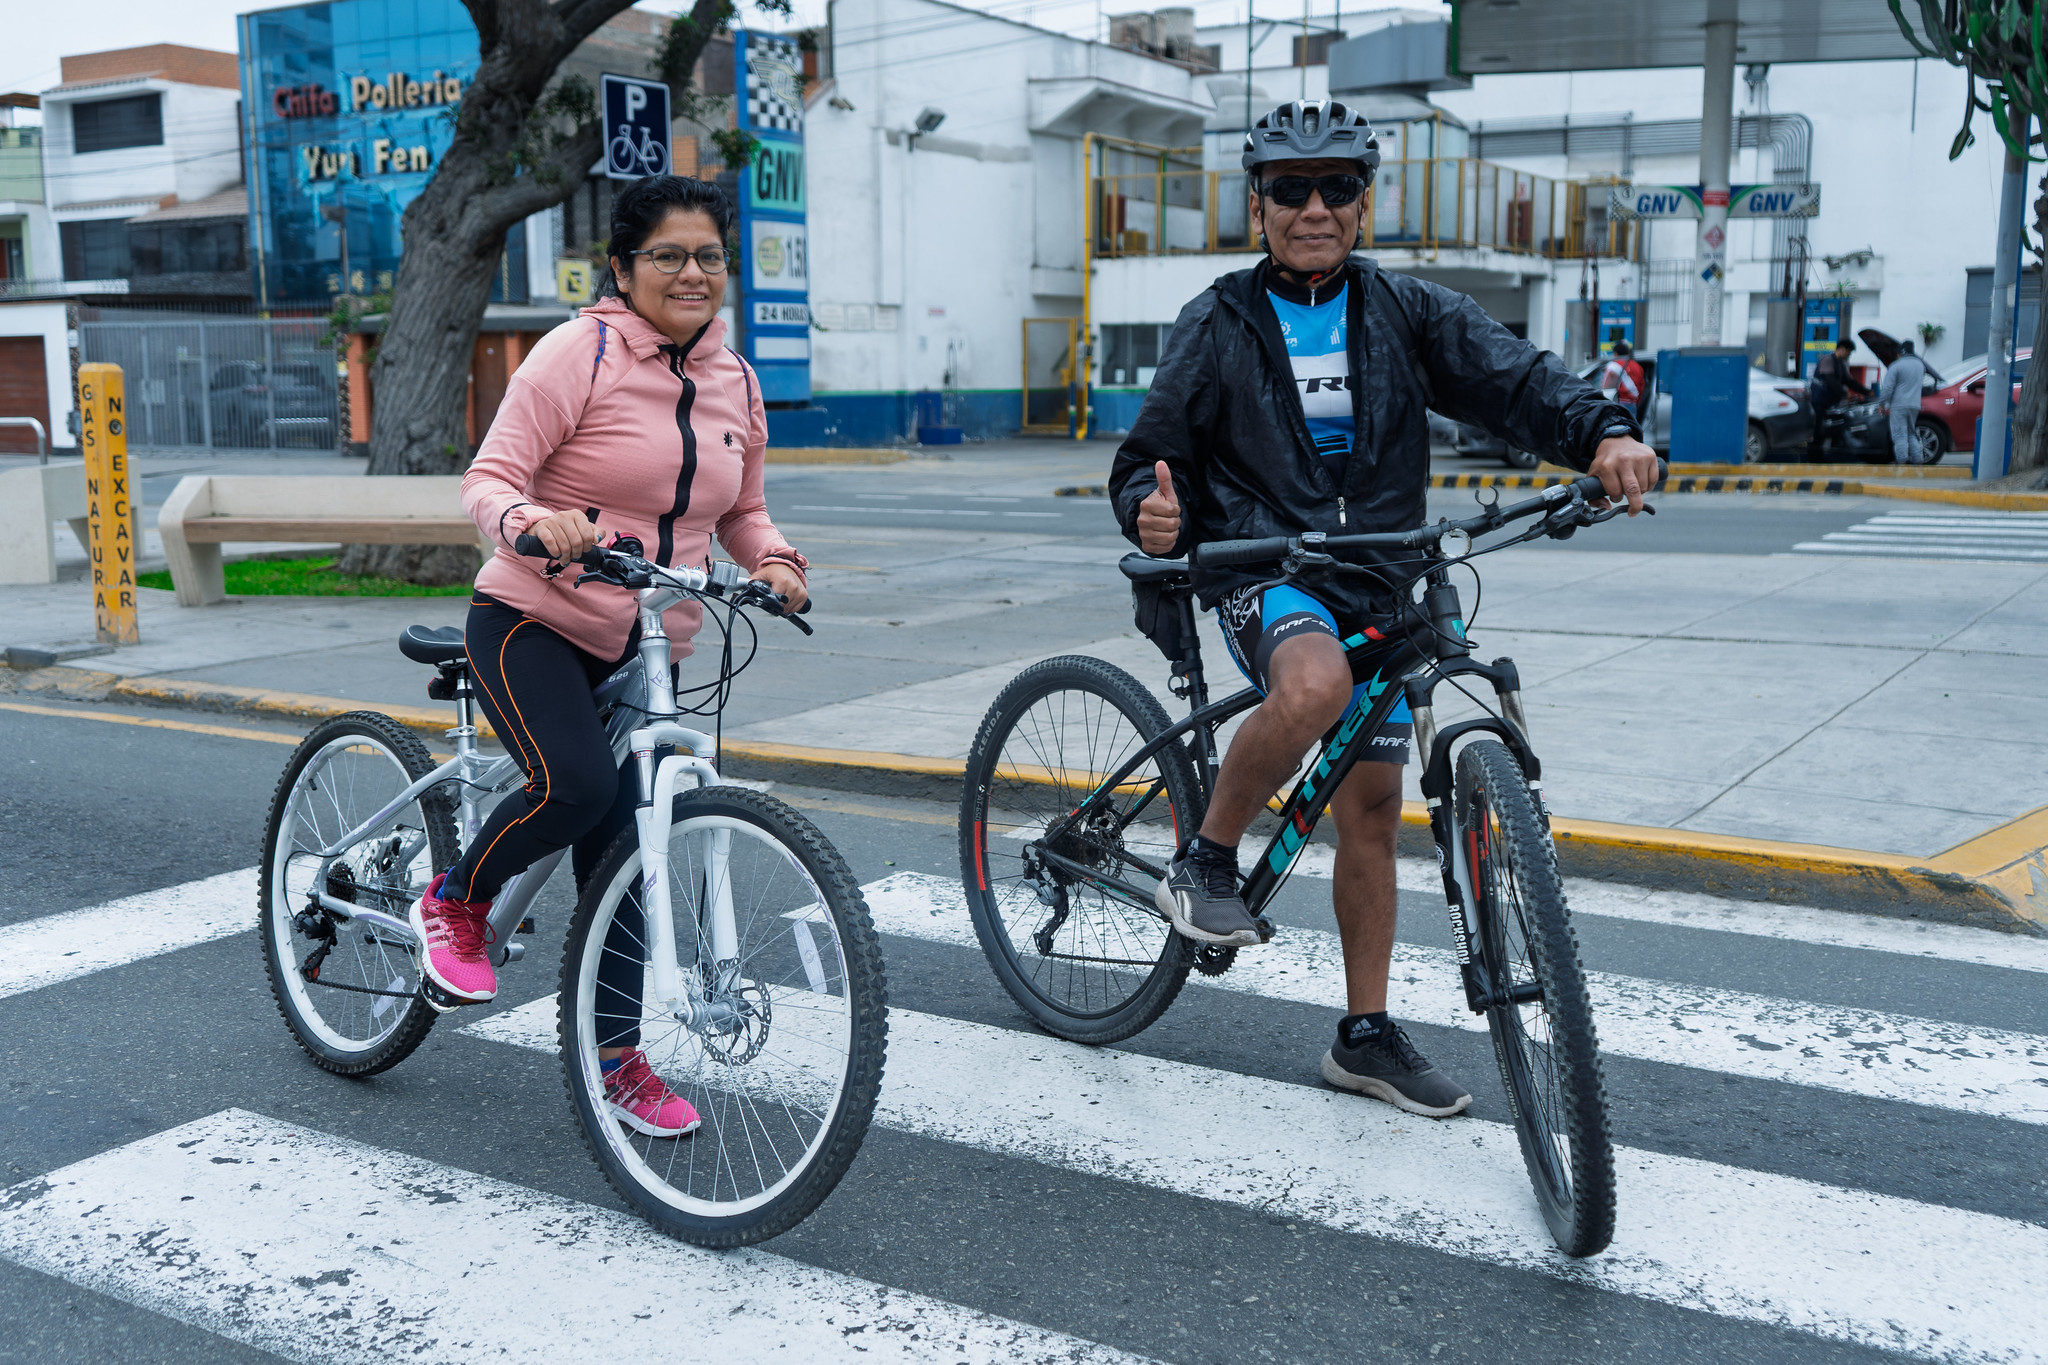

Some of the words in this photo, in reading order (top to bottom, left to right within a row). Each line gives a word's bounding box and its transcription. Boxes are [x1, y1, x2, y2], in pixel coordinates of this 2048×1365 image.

[274, 84, 334, 117] Chifa
[350, 70, 461, 111] Polleria
[625, 84, 647, 121] P
[373, 138, 428, 174] Fen
[758, 147, 804, 202] GNV
[1637, 192, 1684, 215] GNV
[1749, 191, 1795, 214] GNV
[760, 306, 778, 321] 24
[82, 384, 96, 447] GAS
[108, 397, 123, 436] NO
[88, 478, 107, 632] NATURAL
[112, 455, 133, 608] EXCAVAR
[977, 710, 1003, 756] KENDA
[1297, 666, 1389, 802] TREK
[1448, 904, 1471, 965] ROCKSHOX
[1495, 1041, 1519, 1119] KENDATIRE.COM
